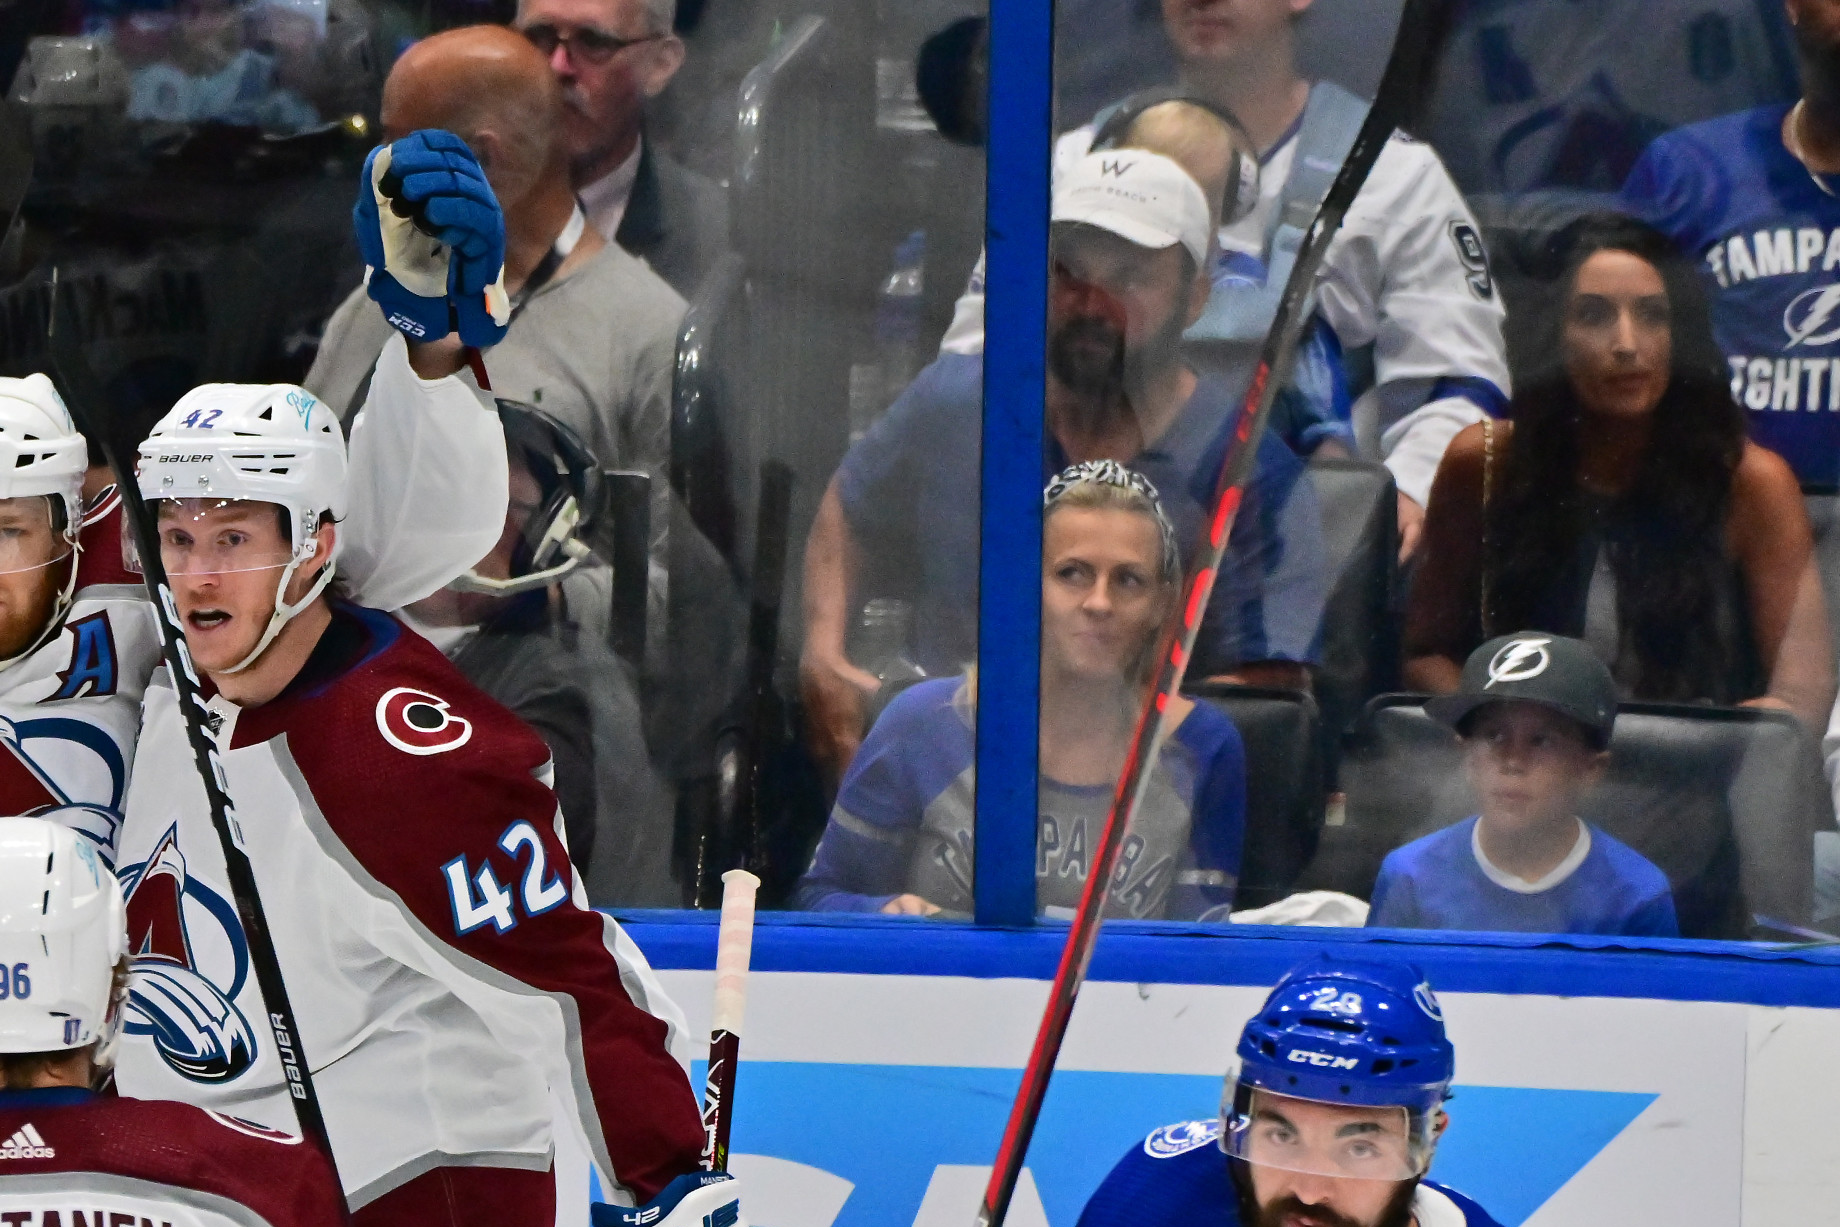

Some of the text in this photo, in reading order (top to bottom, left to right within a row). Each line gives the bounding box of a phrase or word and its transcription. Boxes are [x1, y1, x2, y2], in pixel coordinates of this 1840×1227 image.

[180, 409, 224, 429] 42
[36, 609, 118, 703] A
[440, 818, 569, 937] 42
[1287, 1049, 1359, 1070] CCM
[623, 1206, 661, 1226] 42
